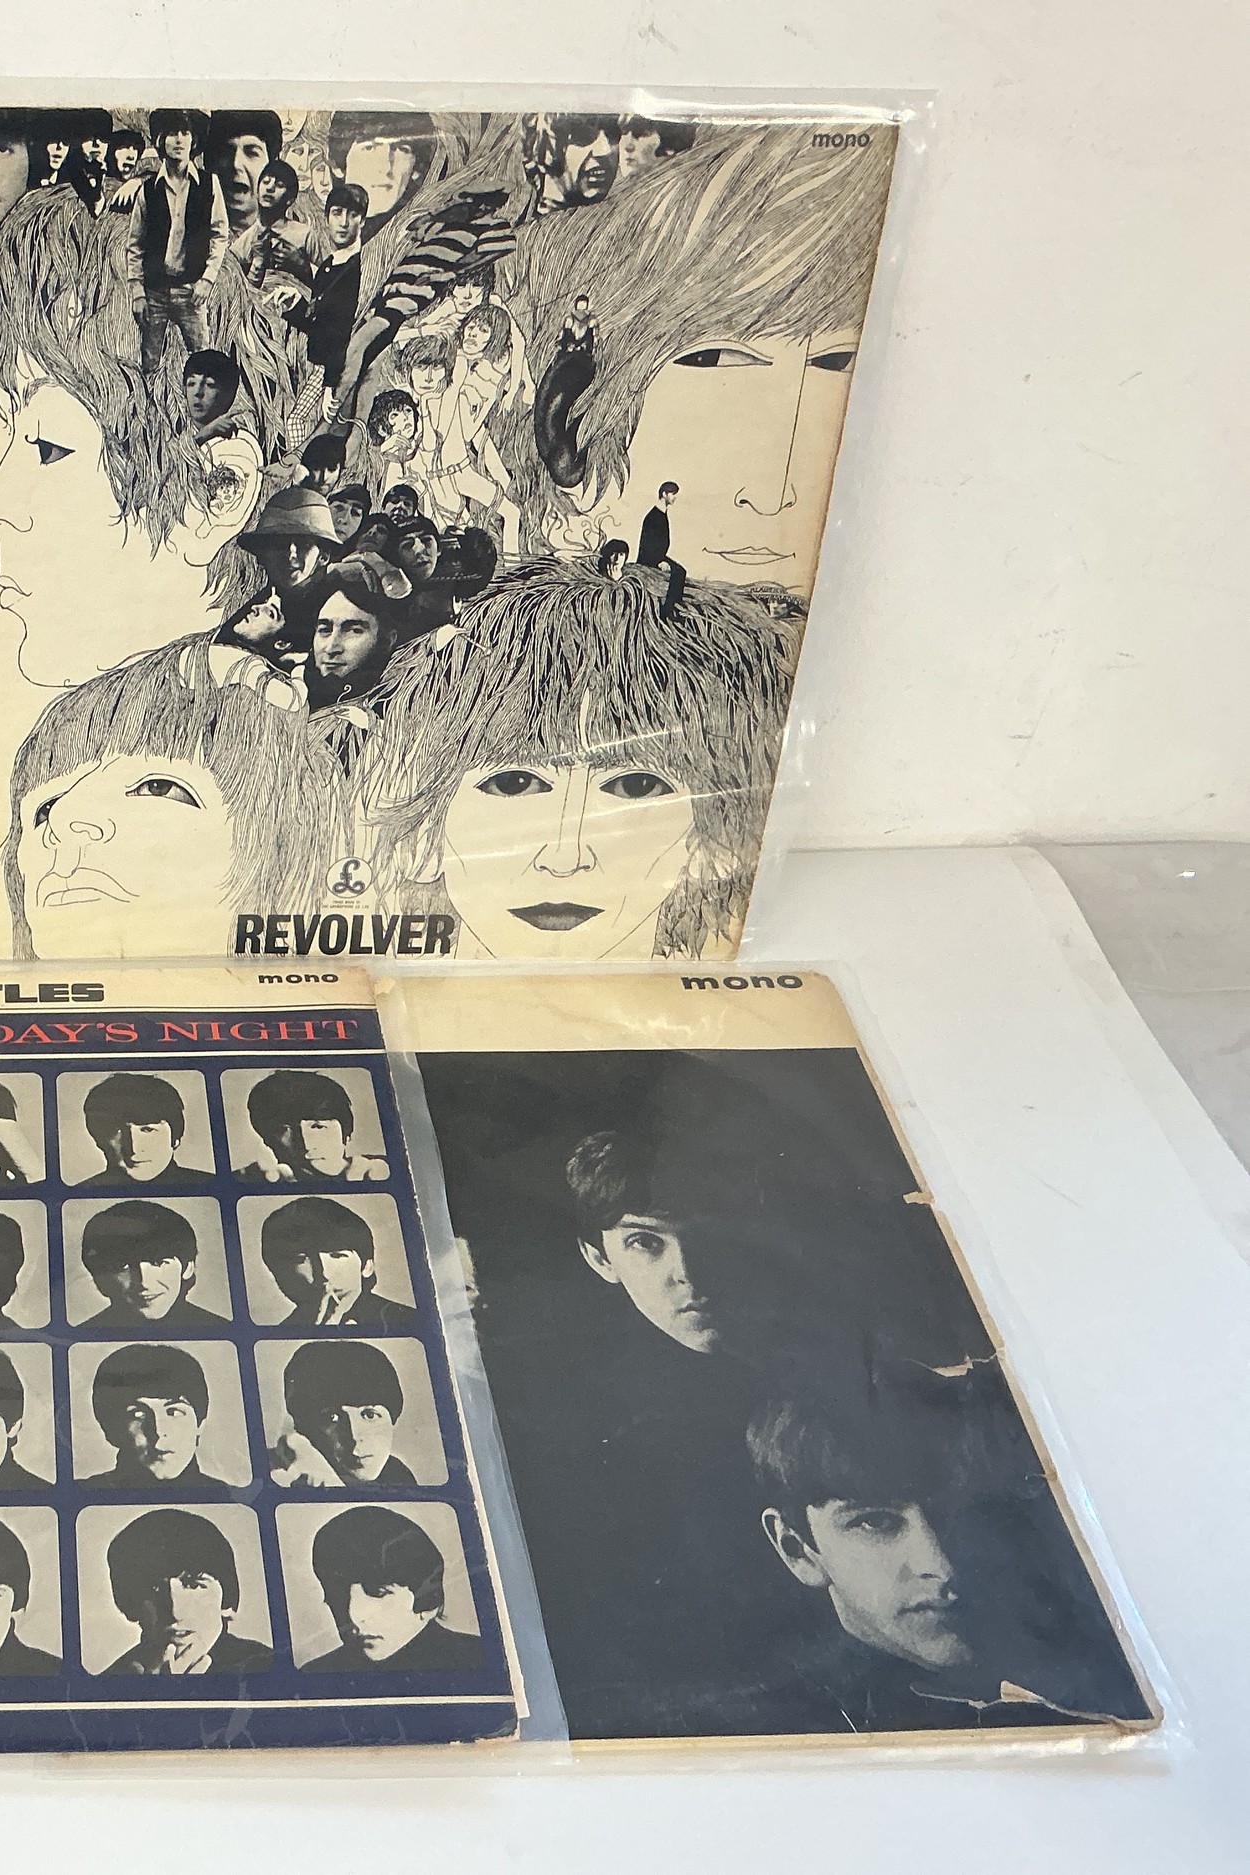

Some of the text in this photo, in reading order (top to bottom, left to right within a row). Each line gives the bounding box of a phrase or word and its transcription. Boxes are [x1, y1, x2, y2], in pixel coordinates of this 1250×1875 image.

[812, 133, 870, 148] mono
[235, 914, 456, 955] REVOLVER
[258, 973, 339, 984] mono
[681, 975, 804, 990] mono
[157, 1019, 358, 1043] NIGHT
